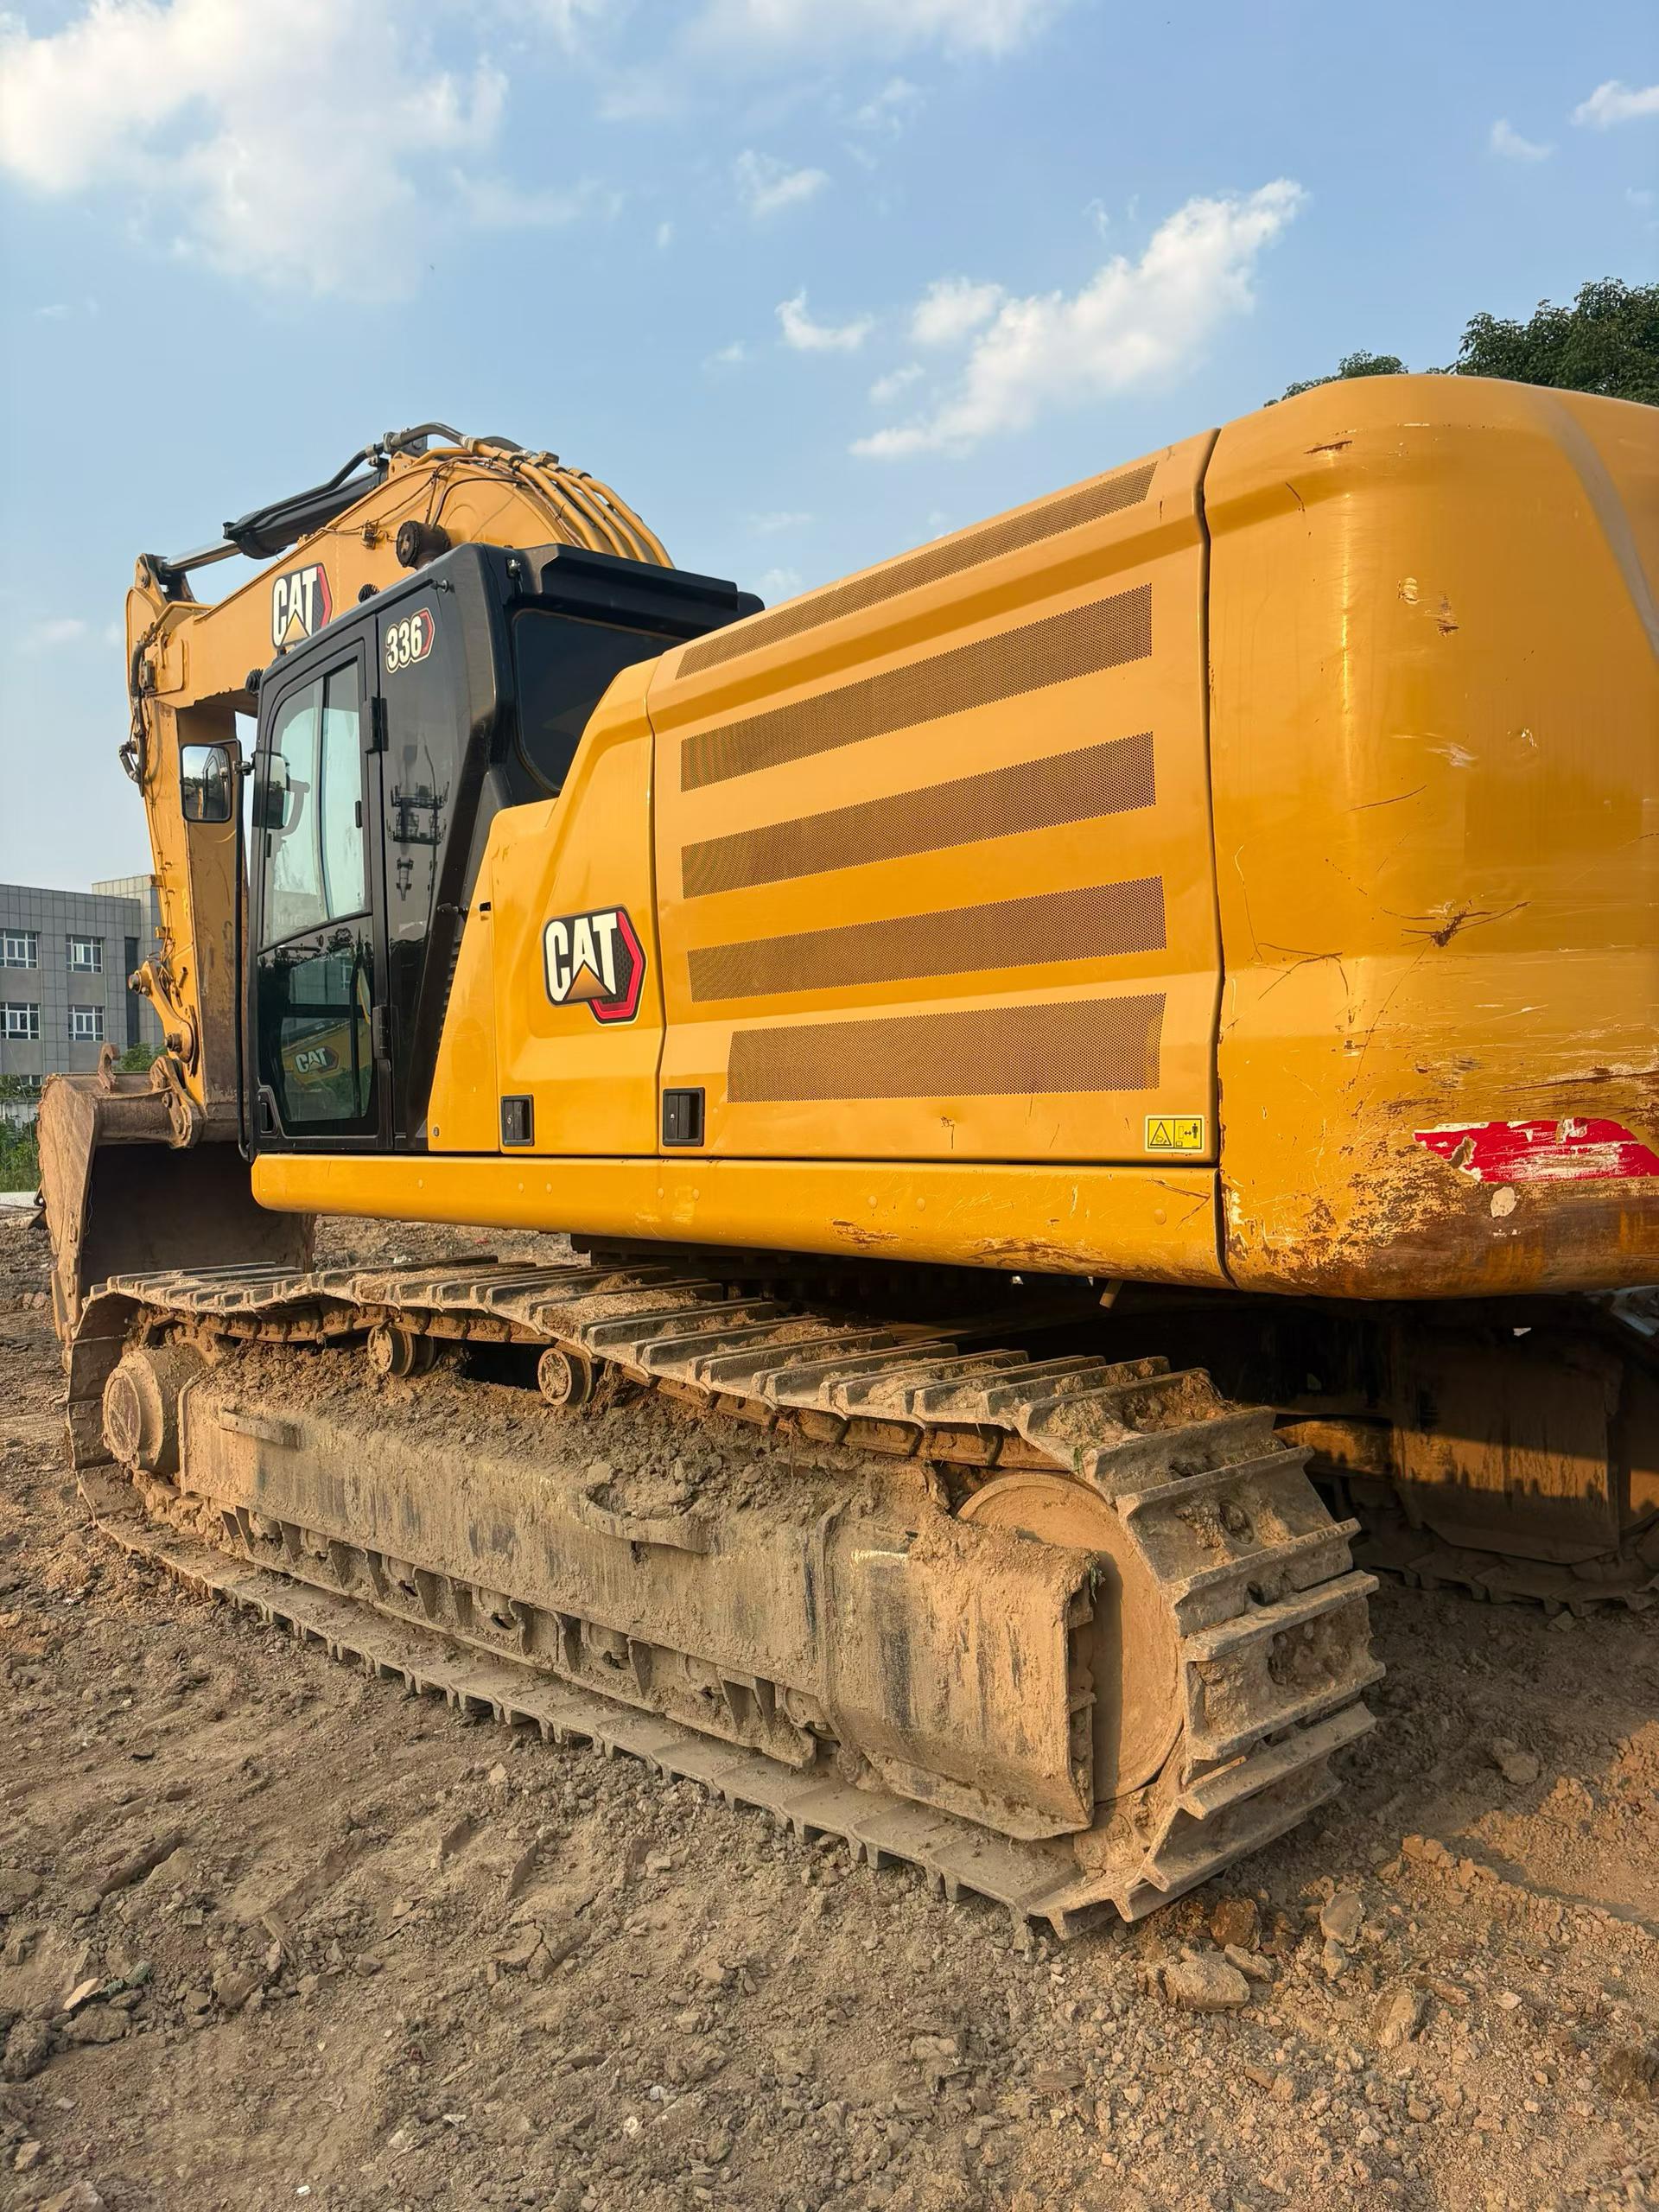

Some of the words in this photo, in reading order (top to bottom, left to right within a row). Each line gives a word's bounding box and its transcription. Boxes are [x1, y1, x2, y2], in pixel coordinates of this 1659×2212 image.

[273, 567, 317, 646] CAT
[387, 615, 423, 669] 336
[545, 912, 618, 1002] CAT
[296, 1047, 327, 1073] CAT
